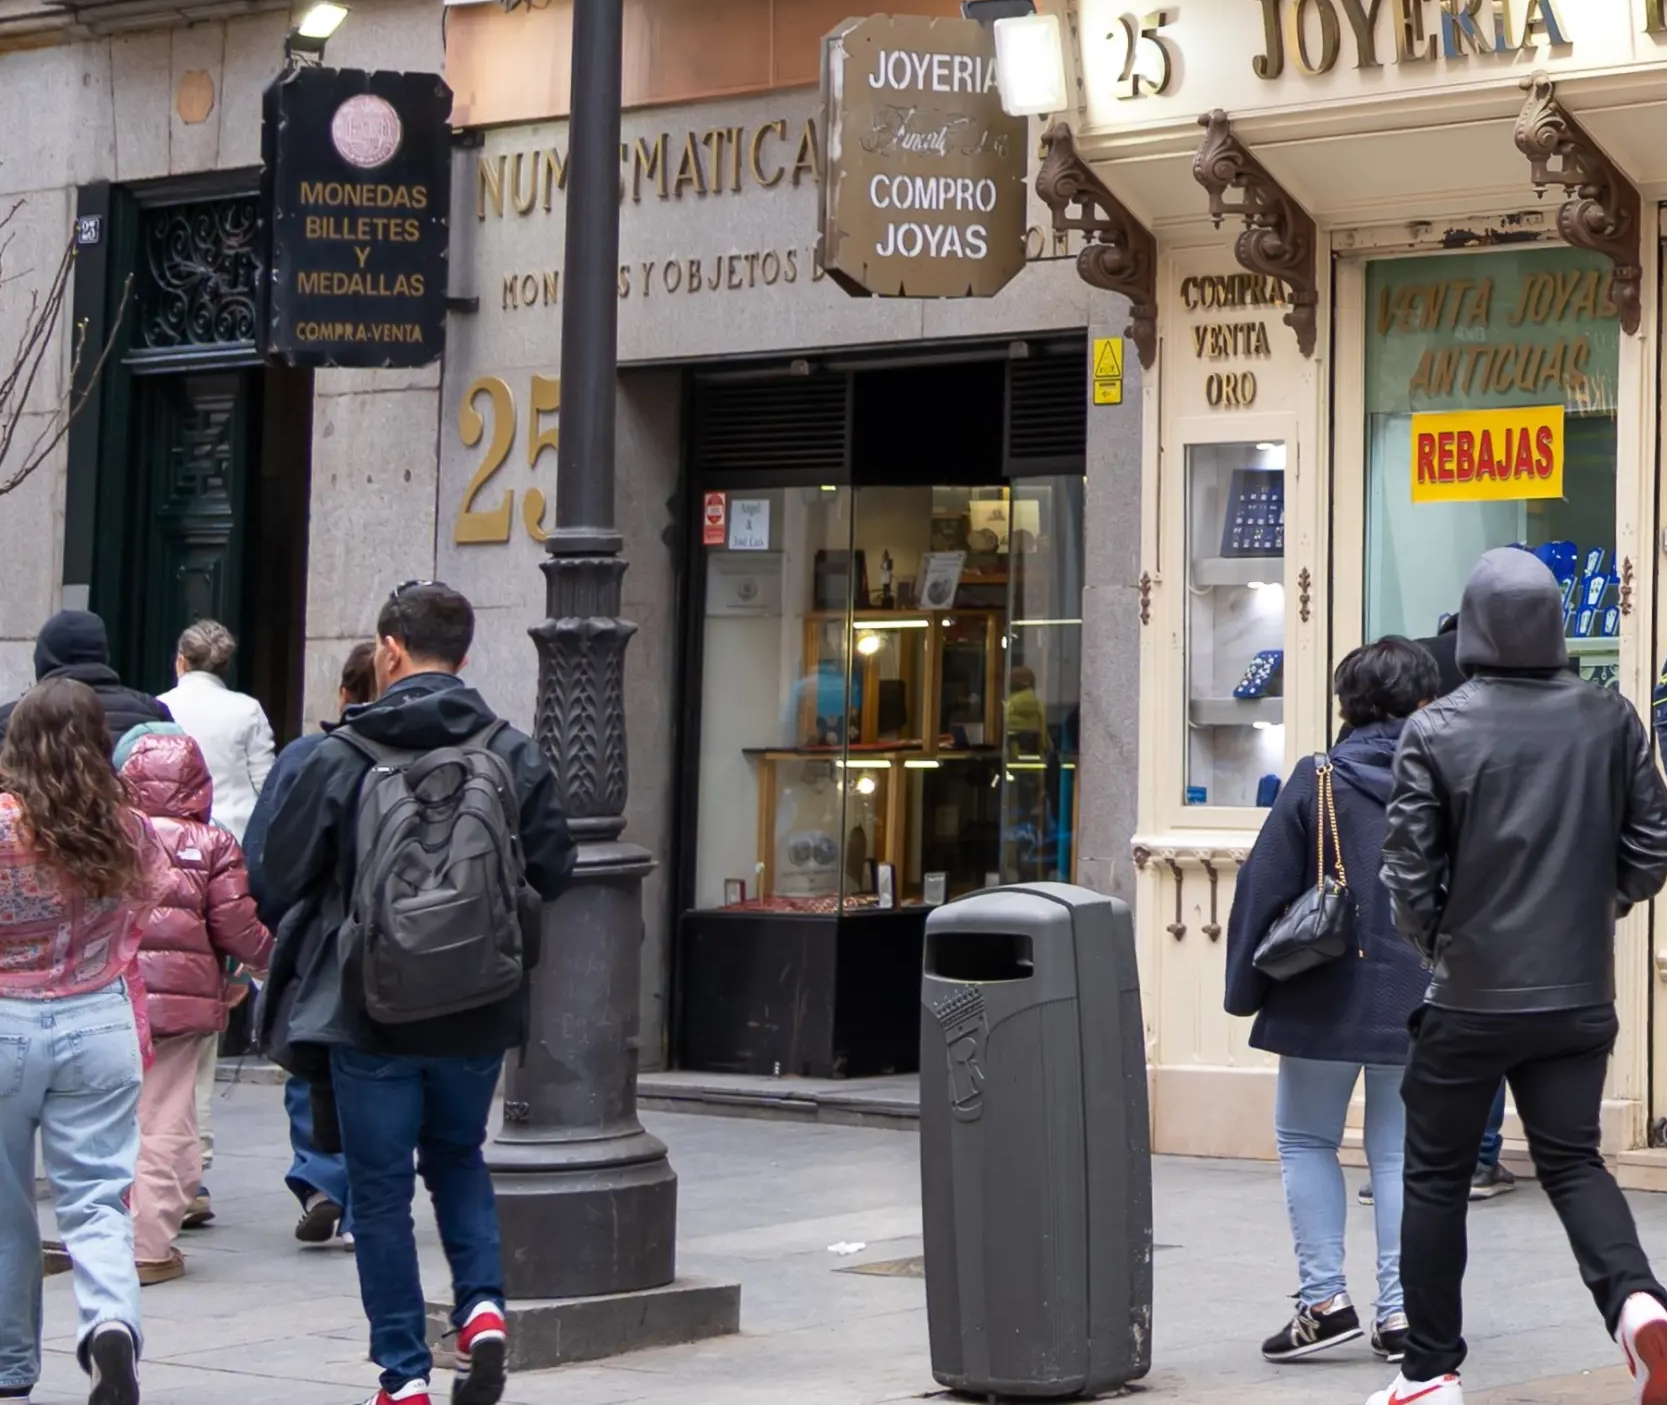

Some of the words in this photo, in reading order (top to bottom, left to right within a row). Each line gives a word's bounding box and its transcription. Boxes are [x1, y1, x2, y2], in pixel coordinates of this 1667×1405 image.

[869, 50, 999, 94] JOYERIA
[1107, 10, 1174, 100] 25
[477, 118, 820, 221] NUMMATICA
[300, 181, 428, 208] MONEDAS
[870, 173, 997, 212] COMPRO
[305, 215, 420, 241] BILLETES
[876, 222, 988, 259] JOYAS
[354, 246, 371, 268] Y
[297, 271, 425, 296] MEDALLAS
[502, 262, 631, 310] MONS
[663, 248, 797, 295] OBJETOS
[1181, 273, 1289, 310] COMPRA
[1378, 275, 1492, 336] VENTA
[1508, 267, 1620, 328] JOYAS
[296, 321, 423, 343] COMPRA-VENTA
[1191, 322, 1271, 359] VENTA
[1205, 371, 1257, 407] ORO
[1417, 424, 1555, 484] REBAJAS
